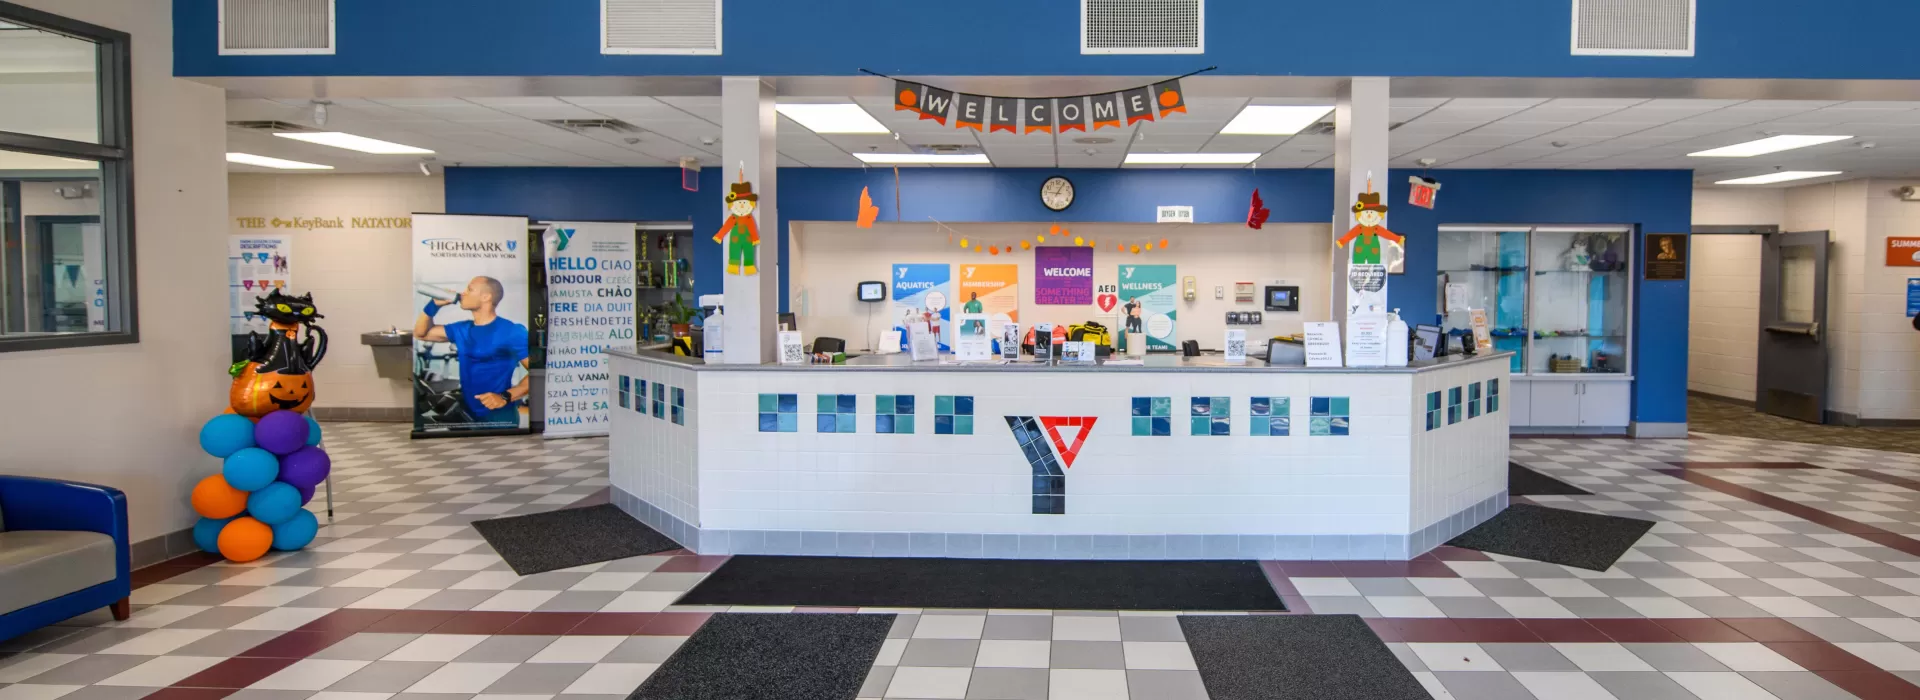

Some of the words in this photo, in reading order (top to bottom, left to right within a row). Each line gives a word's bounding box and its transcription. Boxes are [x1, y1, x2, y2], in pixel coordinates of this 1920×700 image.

[928, 94, 1145, 122] WELCOME
[236, 217, 266, 229] THE
[293, 216, 344, 231] KeyBank
[430, 240, 503, 252] HIGHMARK
[549, 257, 597, 270] HELLO
[601, 259, 632, 270] CIAO
[1043, 267, 1091, 277] WELCOME
[550, 274, 602, 284] BONJOUR
[896, 281, 934, 290] AQUATICS
[1098, 285, 1116, 293] AED
[1122, 282, 1162, 290] WELLNESS
[597, 285, 632, 297] CHÀO
[1036, 287, 1090, 296] SOMETHING
[1036, 296, 1076, 304] GREATER
[550, 302, 578, 312] TERE
[584, 303, 603, 312] DIA
[607, 302, 632, 312] DUIT
[609, 328, 633, 339] ALO
[547, 360, 598, 369] HUJAMBO
[548, 390, 568, 398] SZIA
[571, 385, 599, 397] שלום
[550, 401, 588, 413] 今日は
[548, 413, 582, 425] HALLÅ
